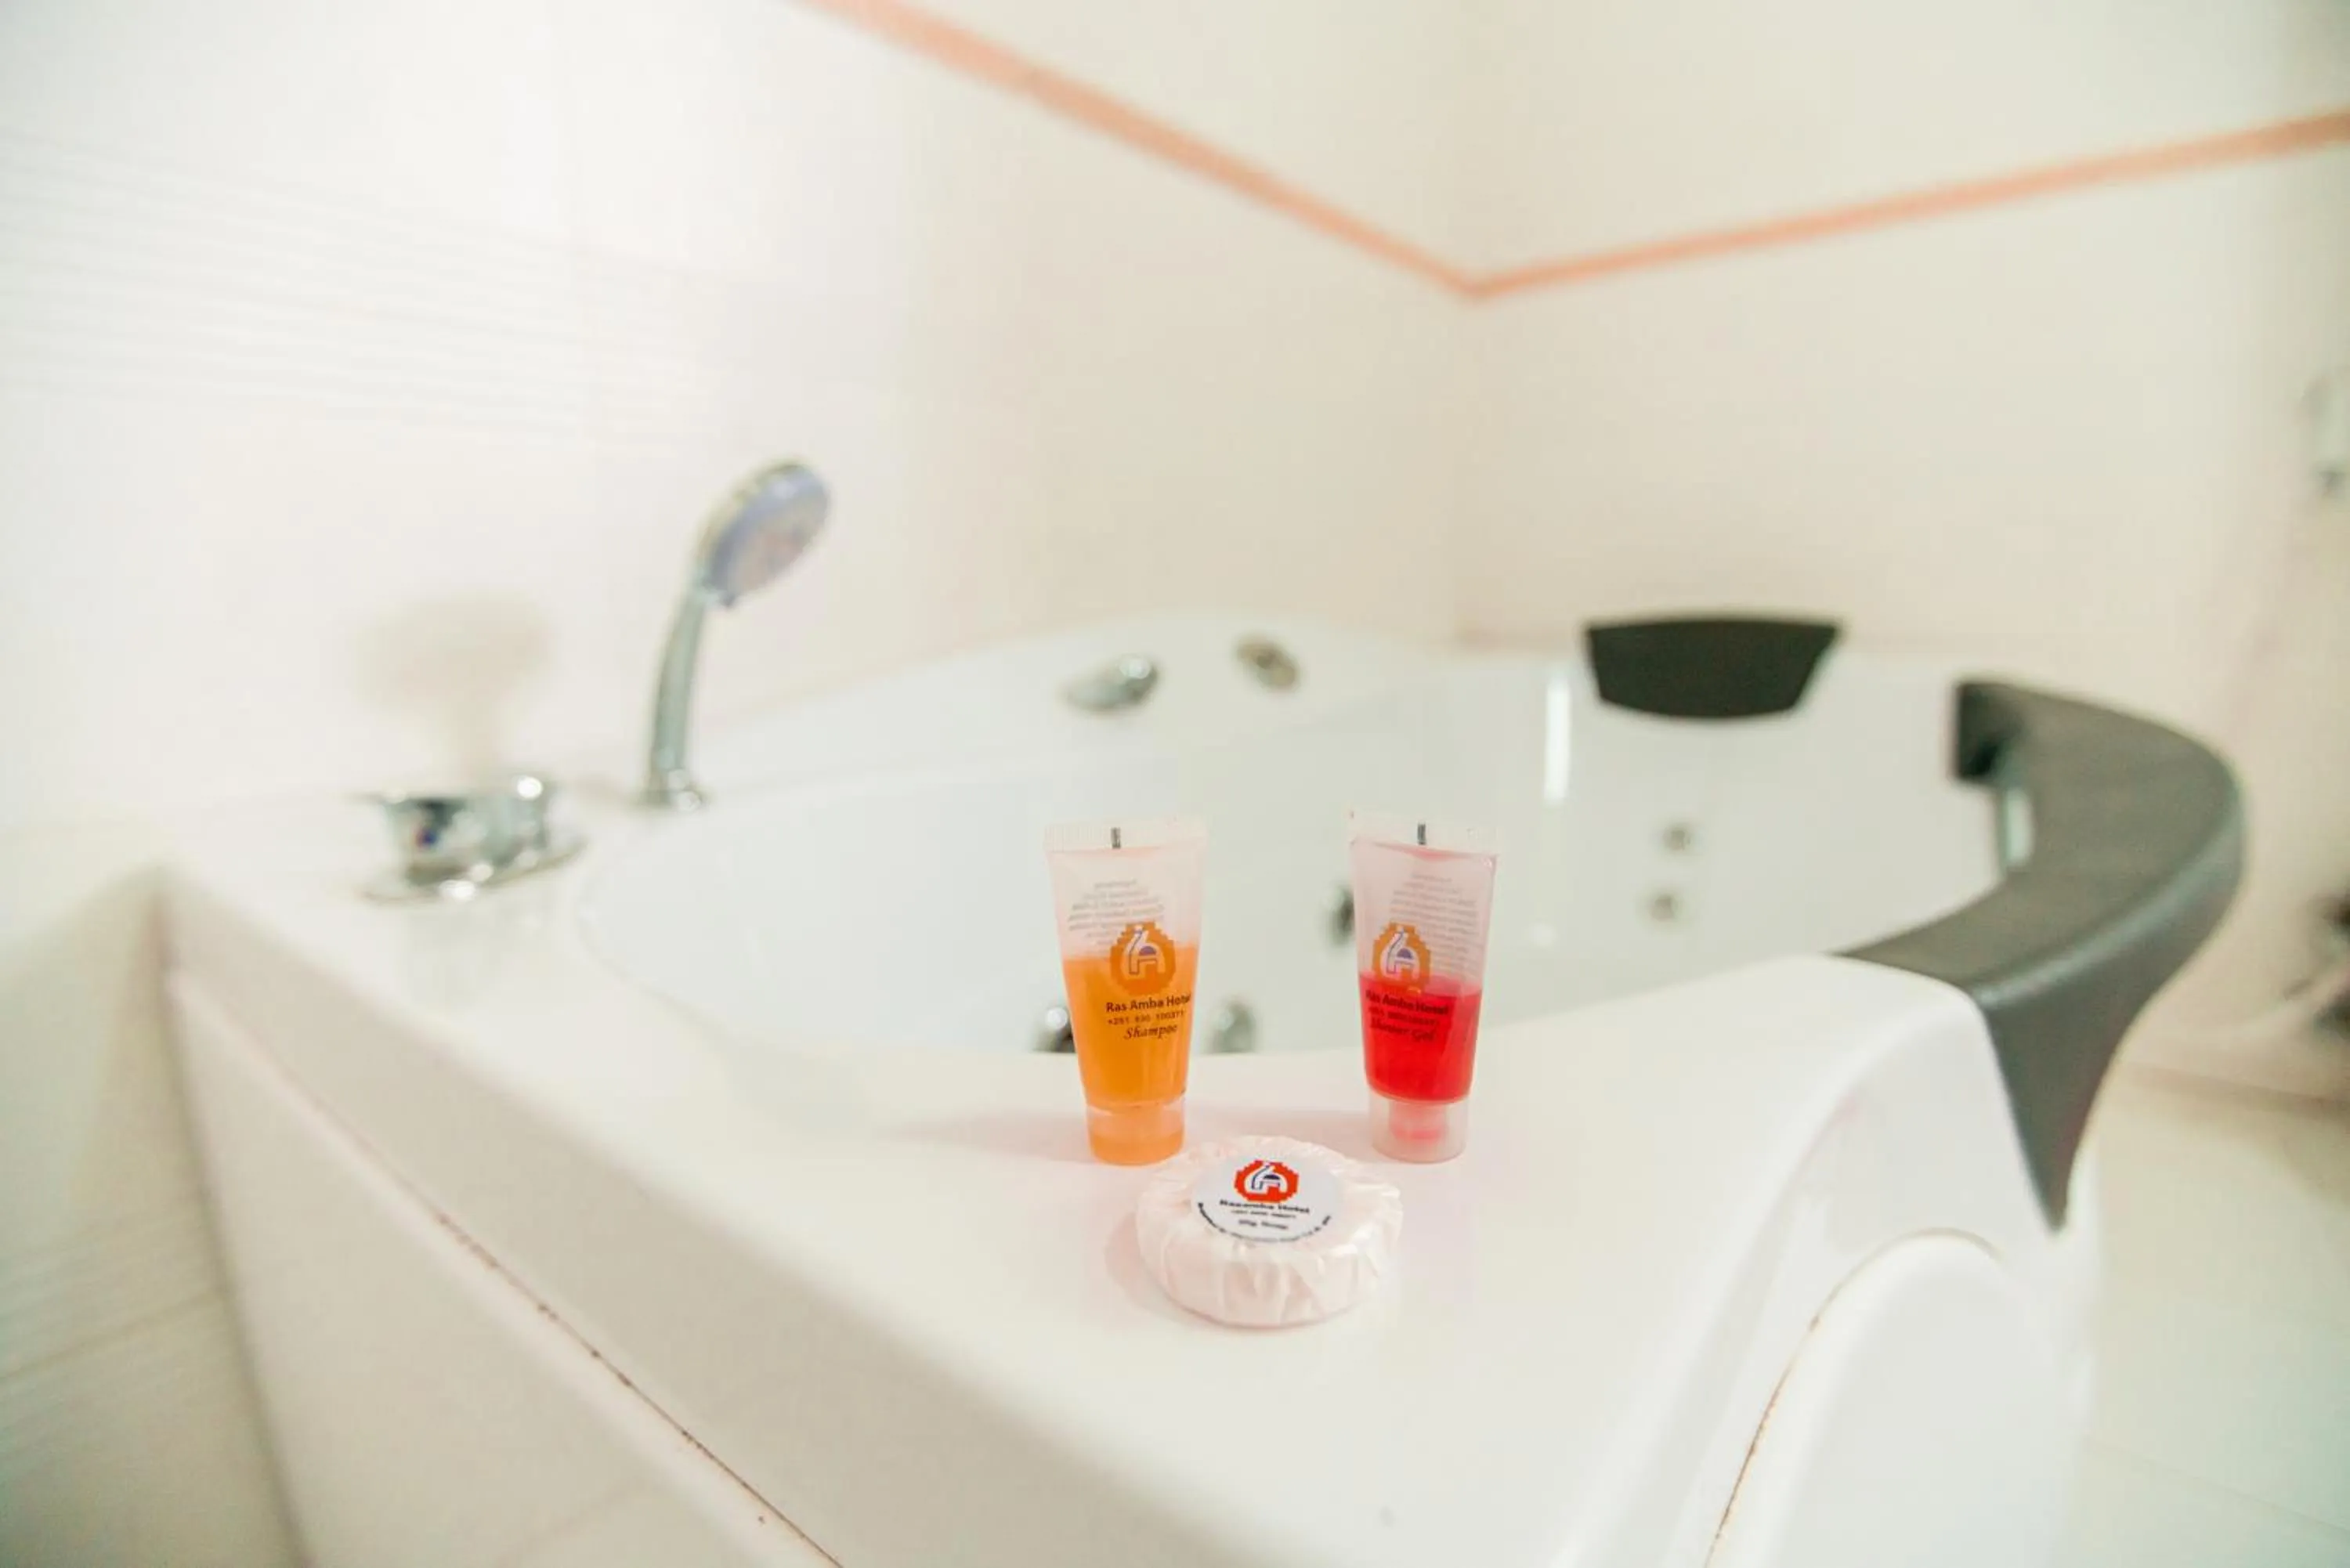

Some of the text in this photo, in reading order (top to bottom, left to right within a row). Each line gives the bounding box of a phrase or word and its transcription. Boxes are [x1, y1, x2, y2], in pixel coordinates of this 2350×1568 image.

[1106, 1002, 1127, 1013] Ras
[1130, 997, 1164, 1010] Amba
[1123, 1024, 1177, 1039] Shampoo
